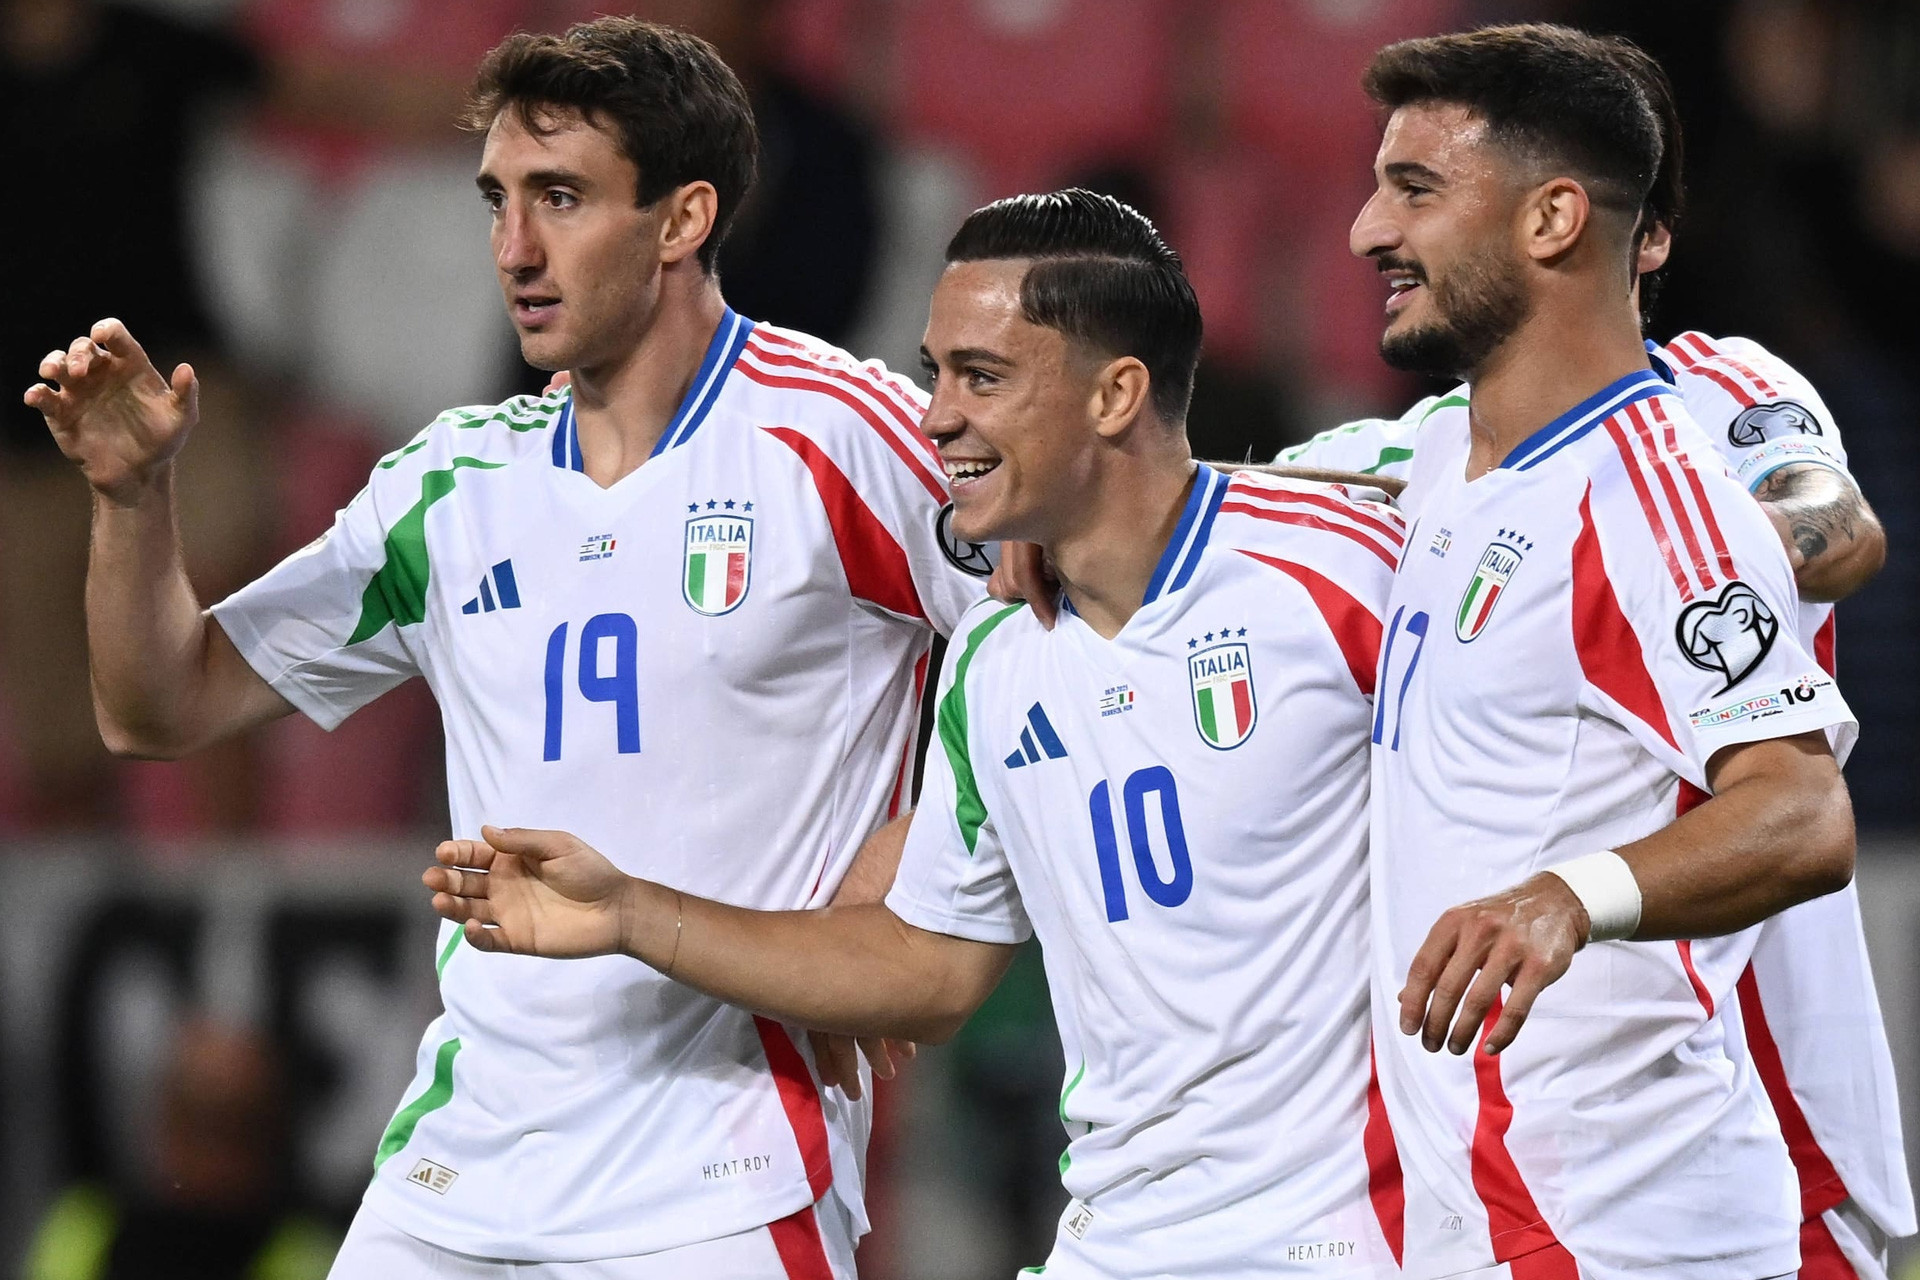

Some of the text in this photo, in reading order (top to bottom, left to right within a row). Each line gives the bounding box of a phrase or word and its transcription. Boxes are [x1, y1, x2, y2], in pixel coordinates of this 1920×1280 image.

[690, 525, 746, 543] ITALIA
[1482, 549, 1515, 577] ITALIA
[1194, 651, 1245, 679] ITALIA
[1371, 604, 1430, 752] 17
[543, 612, 641, 762] 19
[1780, 682, 1815, 705] 10
[1692, 697, 1779, 725] FOUNDATION
[1088, 765, 1194, 924] 10
